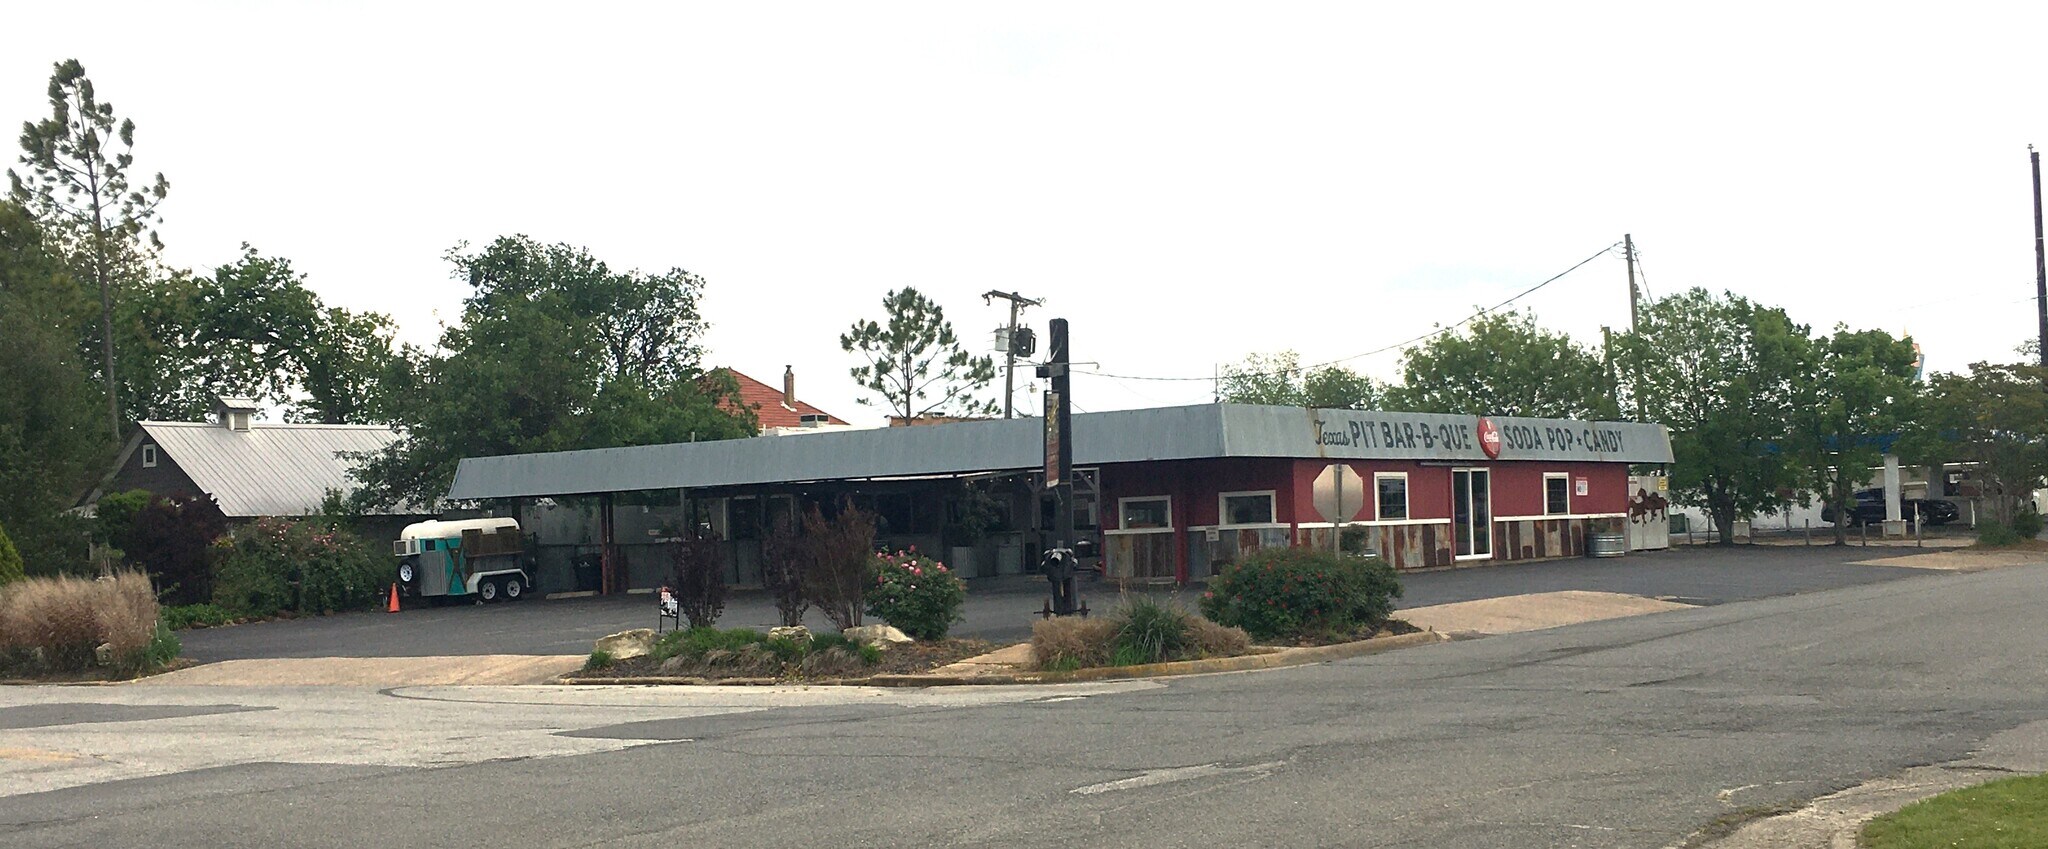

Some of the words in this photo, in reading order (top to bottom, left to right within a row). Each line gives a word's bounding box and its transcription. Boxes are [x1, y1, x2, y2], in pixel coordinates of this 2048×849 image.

[1314, 420, 1350, 446] Texas
[1349, 420, 1377, 448] PIT
[1380, 422, 1472, 451] BAR-B-QUE
[1503, 425, 1544, 450] SODA
[1546, 427, 1573, 451] POP
[1583, 429, 1624, 452] CANDY
